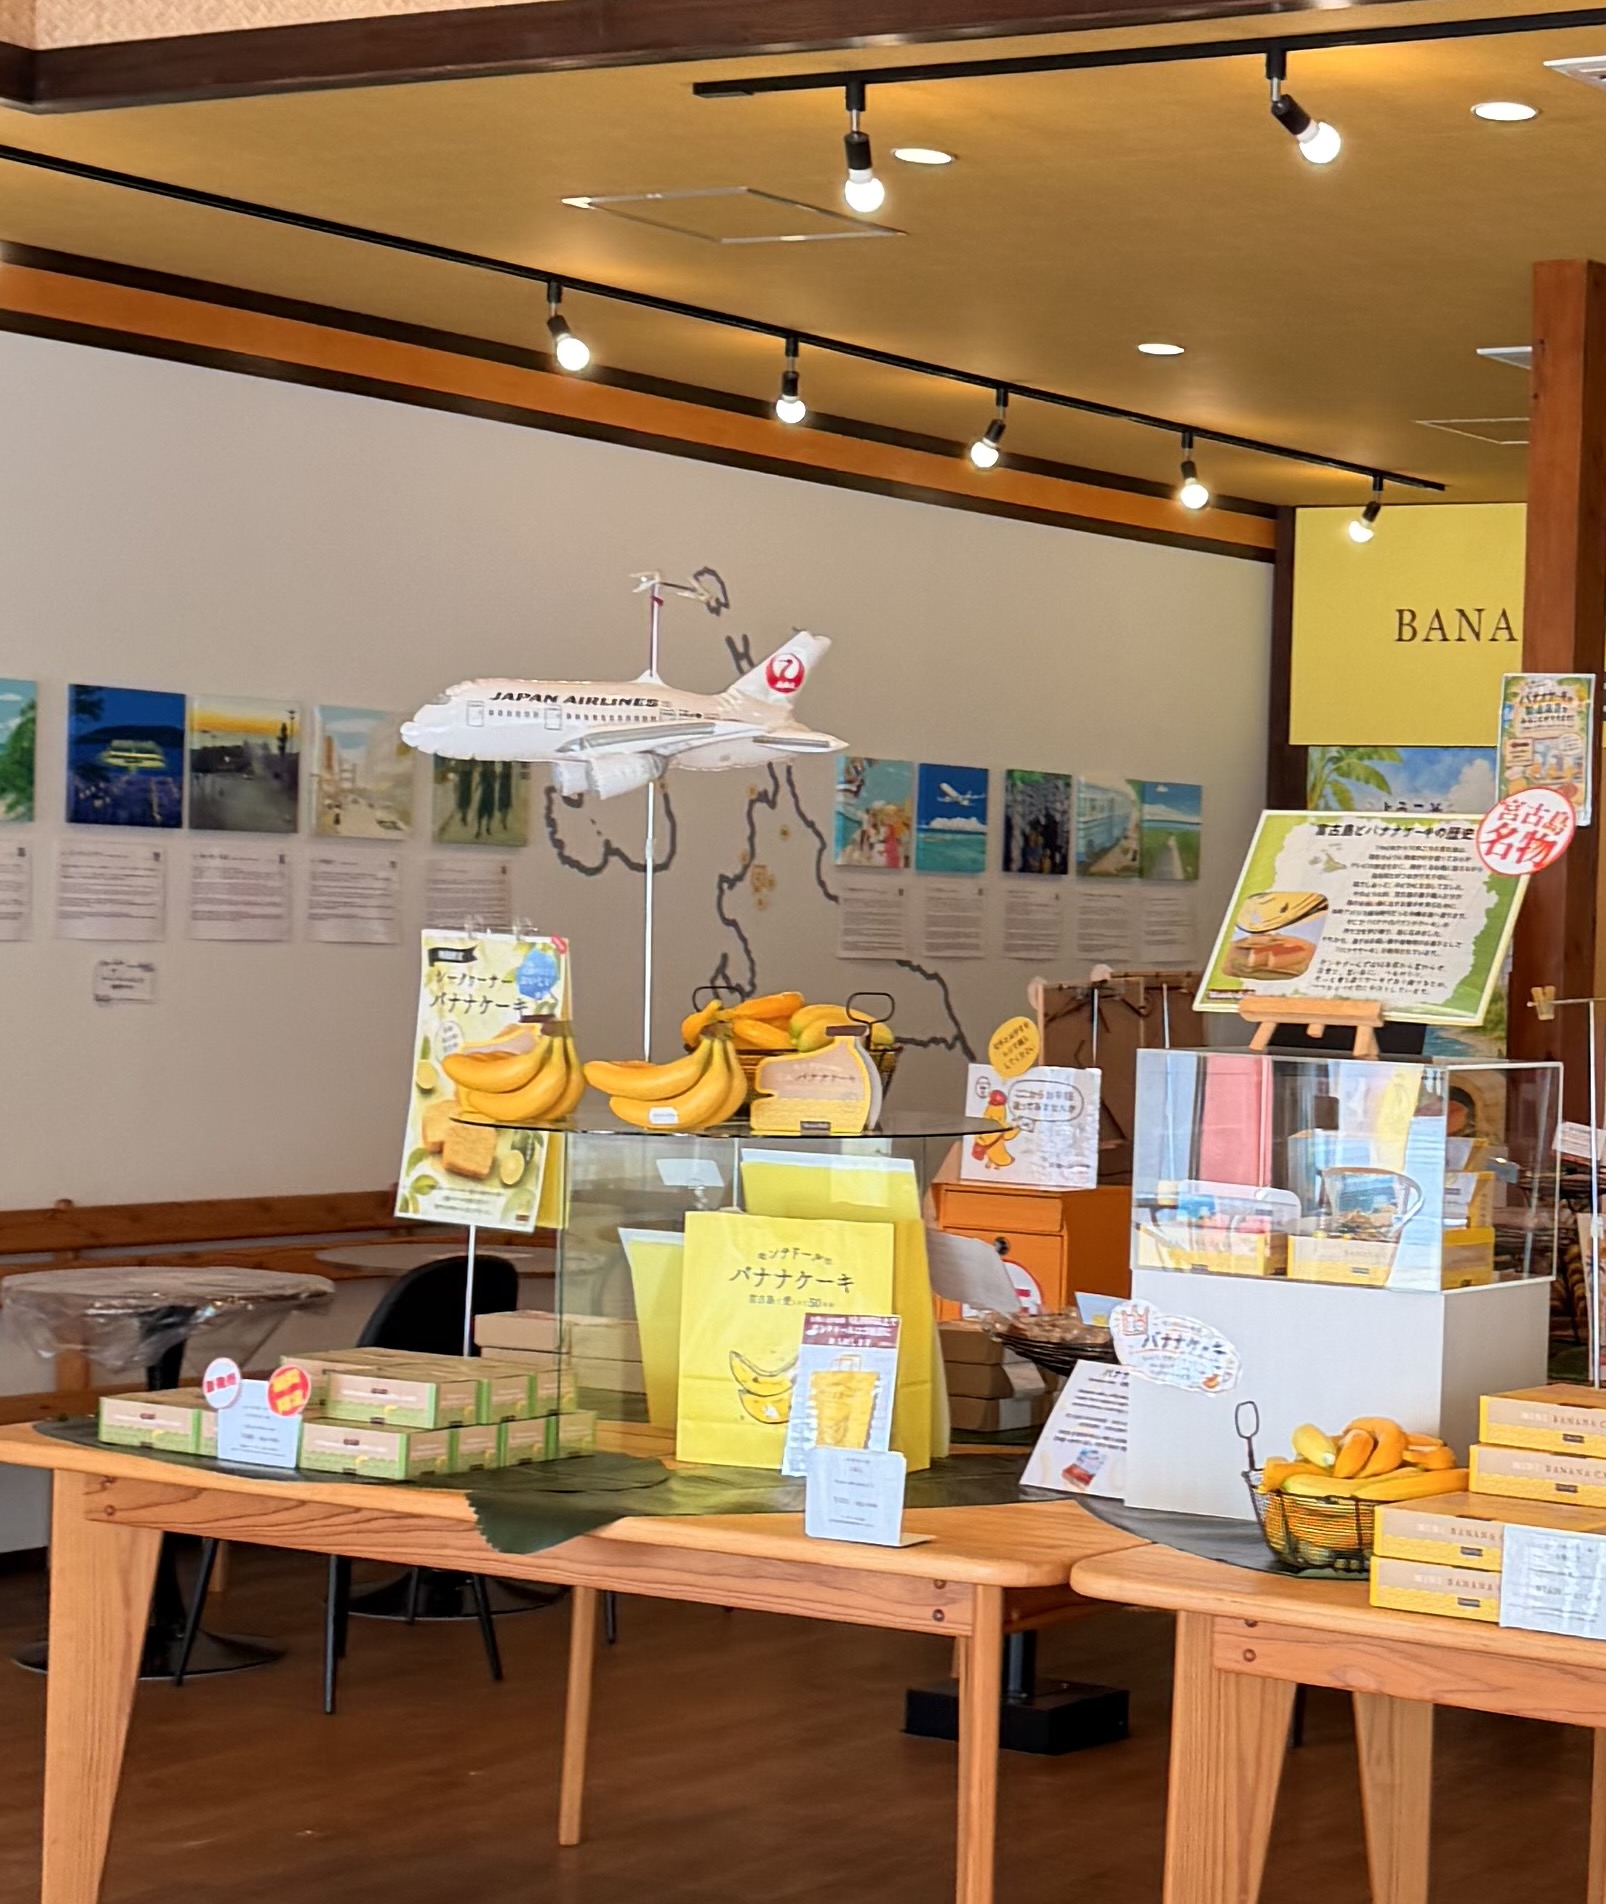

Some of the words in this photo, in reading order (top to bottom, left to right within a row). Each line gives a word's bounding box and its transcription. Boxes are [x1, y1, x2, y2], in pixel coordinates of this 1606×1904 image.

[1395, 607, 1518, 643] BANA
[490, 691, 559, 704] JAPAN
[563, 695, 660, 708] AIRLINES
[1497, 799, 1570, 836] 宮古島
[1481, 821, 1558, 869] 名物
[429, 991, 529, 1017] バナナケーキ
[728, 1265, 855, 1294] バナナケーキ
